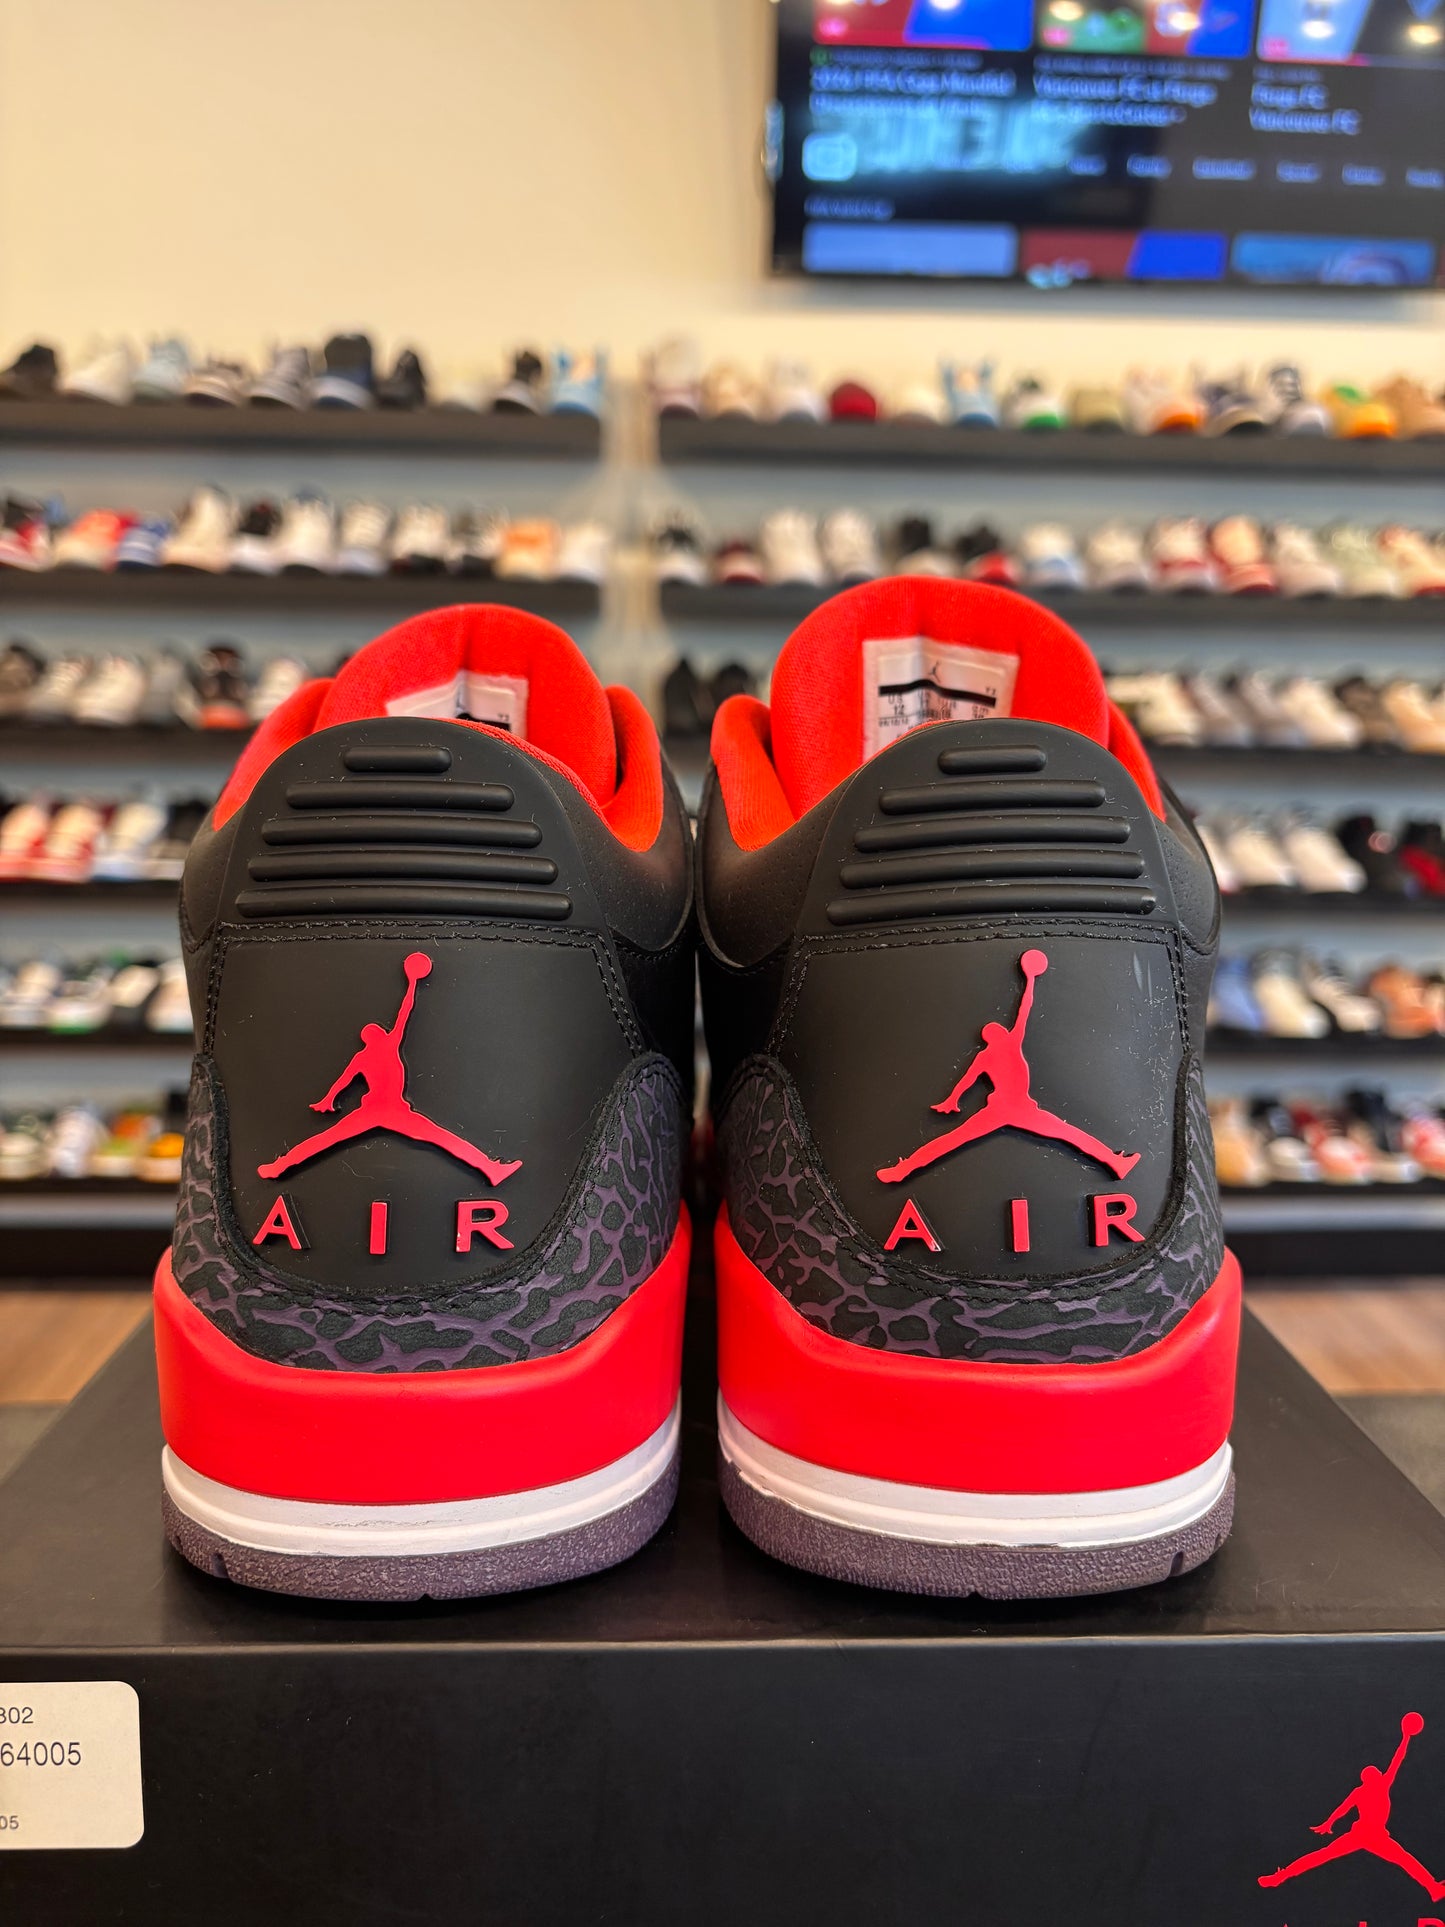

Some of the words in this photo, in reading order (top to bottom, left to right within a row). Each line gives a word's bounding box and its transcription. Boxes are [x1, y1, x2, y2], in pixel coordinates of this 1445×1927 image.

[252, 1194, 515, 1255] AIR
[883, 1193, 1146, 1253] AIR
[0, 1741, 82, 1767] 64005
